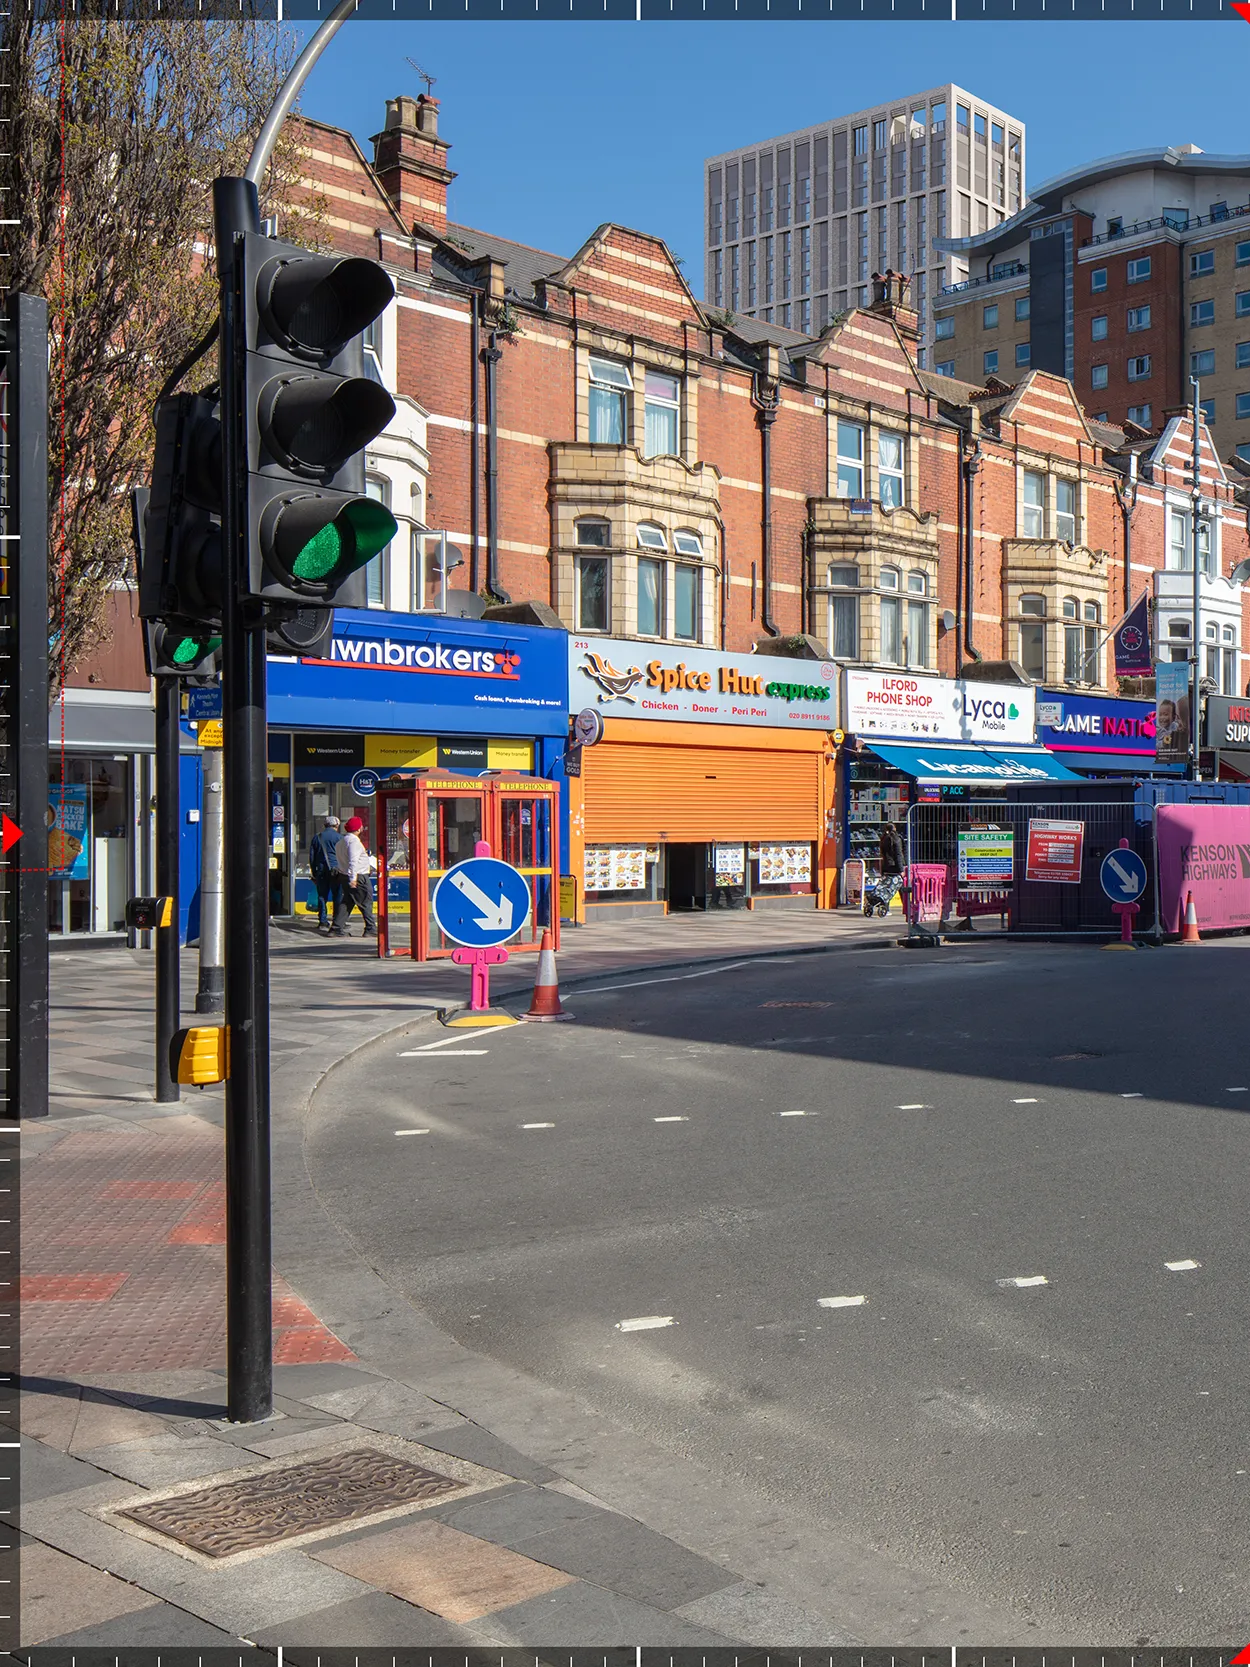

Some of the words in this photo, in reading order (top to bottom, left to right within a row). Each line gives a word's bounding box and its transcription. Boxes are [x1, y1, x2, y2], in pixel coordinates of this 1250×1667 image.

[648, 660, 712, 692] Spice
[718, 667, 764, 696] Hut
[767, 681, 832, 702] express
[882, 678, 918, 692] ILFORD
[474, 694, 487, 702] Cash
[506, 696, 540, 706] Pawnbroking
[867, 692, 902, 705] PHONE
[906, 694, 932, 707] SHOP
[642, 700, 679, 711] Chicken
[692, 703, 718, 714] Doner
[732, 706, 750, 716] Peri
[750, 707, 767, 717] Peri
[963, 694, 1005, 721] Lyca
[982, 720, 1006, 731] Mobile
[917, 758, 1049, 777] Lycamobile
[942, 786, 948, 794] P
[950, 786, 964, 795] ACC
[56, 804, 84, 815] KATSU
[56, 820, 84, 831] BAKE
[1181, 845, 1236, 862] KENSON
[1181, 863, 1237, 882] HIGHWAYS
